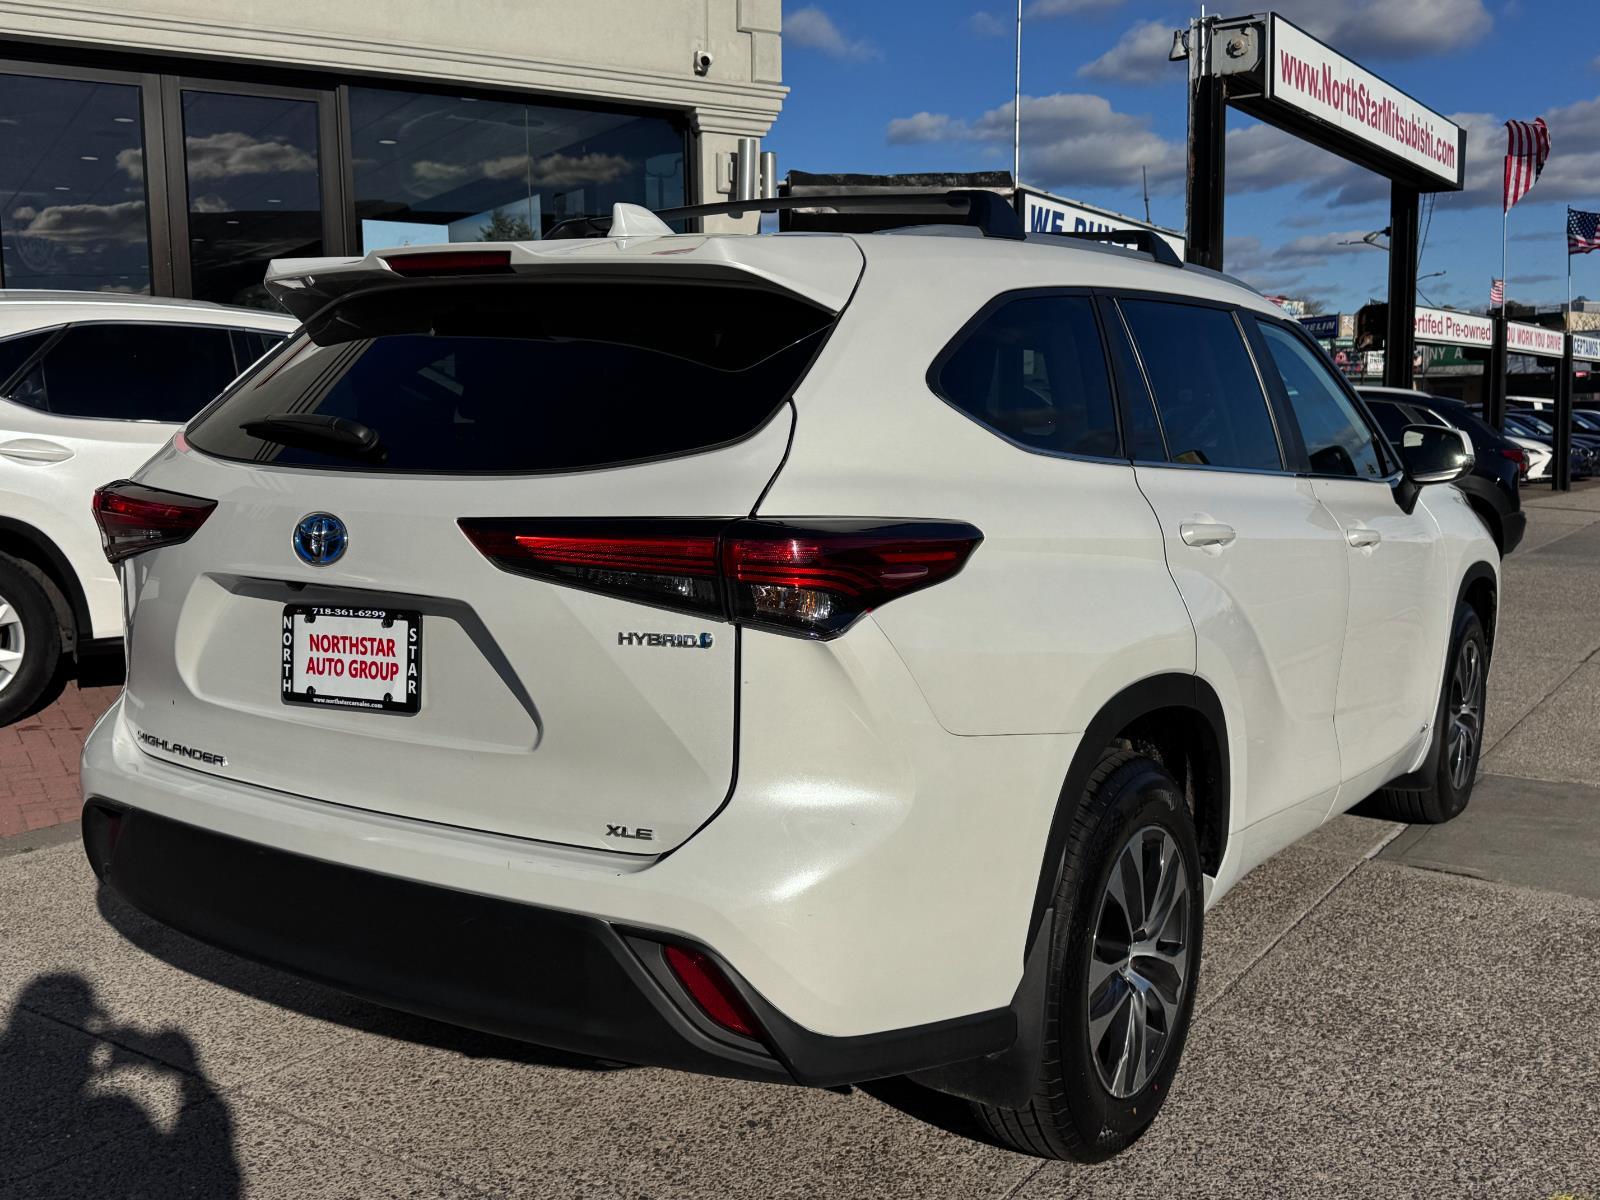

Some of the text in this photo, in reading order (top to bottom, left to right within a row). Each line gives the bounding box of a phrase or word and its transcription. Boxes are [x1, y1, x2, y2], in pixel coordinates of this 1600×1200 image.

[1280, 49, 1456, 169] www.NorthStarMitsubishi.com
[1031, 204, 1065, 233] WE
[1414, 313, 1491, 342] ertifed Pre-owned
[1506, 326, 1562, 351] OU WORK YOU DRIVE
[1573, 336, 1599, 357] CEPTAMOS
[311, 607, 386, 618] 718-361-6299
[309, 633, 396, 657] NORTHSTAR
[618, 631, 698, 648] HYBRID
[283, 615, 292, 693] NORTH
[407, 627, 418, 695] STAR
[306, 656, 399, 681] AUTO GROUP
[137, 730, 227, 767] HIGHLANDER
[605, 824, 653, 840] XLE
